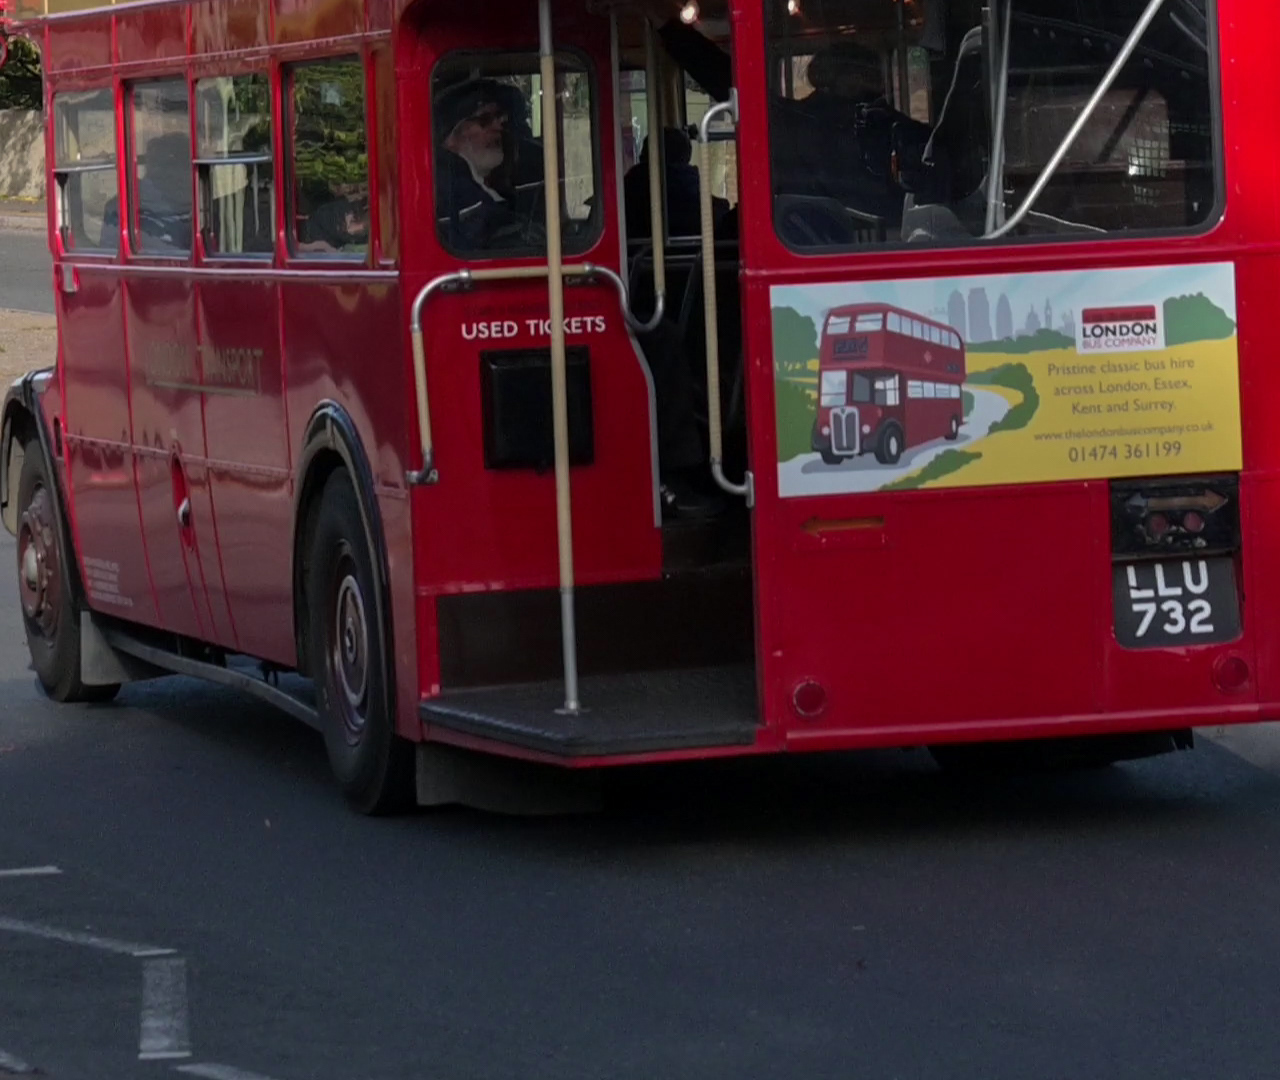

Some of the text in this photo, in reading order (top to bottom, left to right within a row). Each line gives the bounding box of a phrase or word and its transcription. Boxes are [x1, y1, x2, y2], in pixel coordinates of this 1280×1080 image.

[461, 320, 518, 340] USED
[1082, 322, 1157, 338] LONDON
[1082, 335, 1157, 349] BUS COMPANY
[1047, 357, 1195, 376] Pristine classic bus hire
[1054, 384, 1094, 396] across
[1099, 380, 1151, 394] London,
[1072, 398, 1176, 415] Kent and Surrey.
[1034, 421, 1215, 441] www.thelondonbuscompany.co.uk
[1068, 441, 1182, 463] 01474 361199
[1126, 559, 1209, 599] LLU
[1132, 598, 1214, 638] 732
